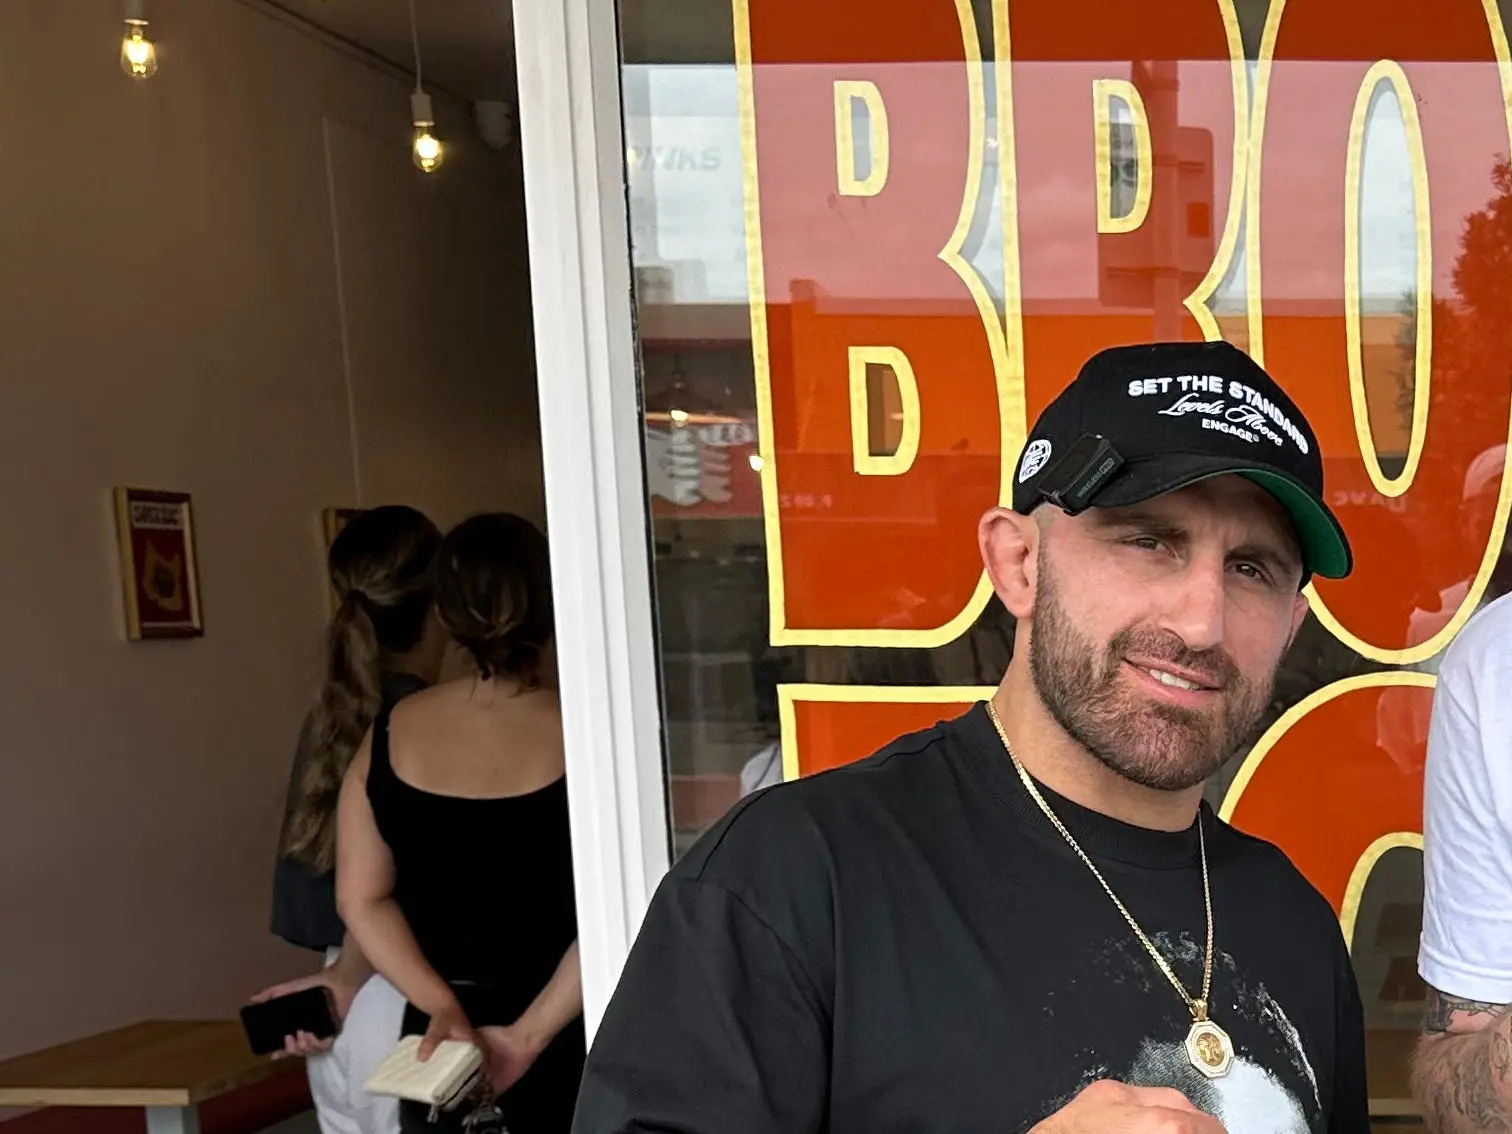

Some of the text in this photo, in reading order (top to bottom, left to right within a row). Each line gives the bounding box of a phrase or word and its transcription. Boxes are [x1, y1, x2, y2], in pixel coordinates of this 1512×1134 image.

[1128, 375, 1309, 454] SET THE STANDARD
